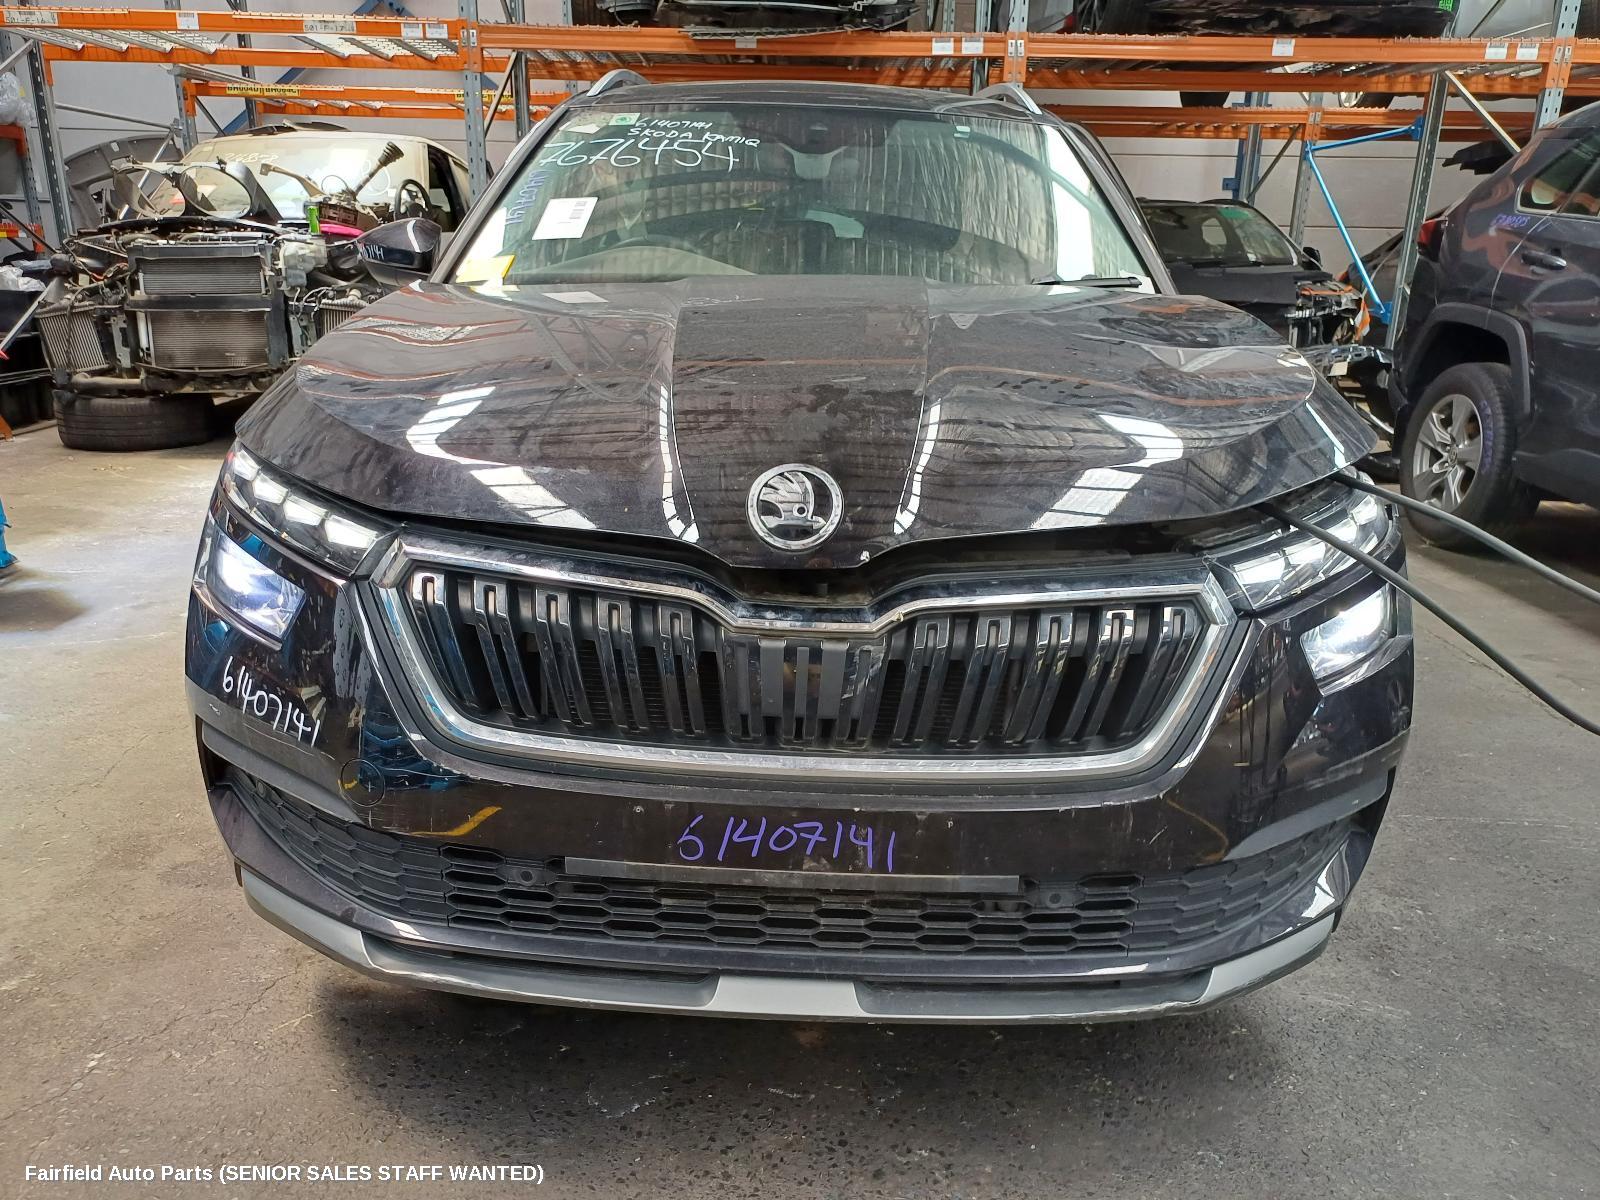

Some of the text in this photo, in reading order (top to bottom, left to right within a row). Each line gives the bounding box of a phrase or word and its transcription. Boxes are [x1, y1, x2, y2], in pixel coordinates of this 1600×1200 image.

[540, 137, 740, 173] 7676454
[627, 127, 761, 148] SKODA KAMIQ
[222, 655, 321, 748] 61407141
[677, 814, 896, 873] 61407141
